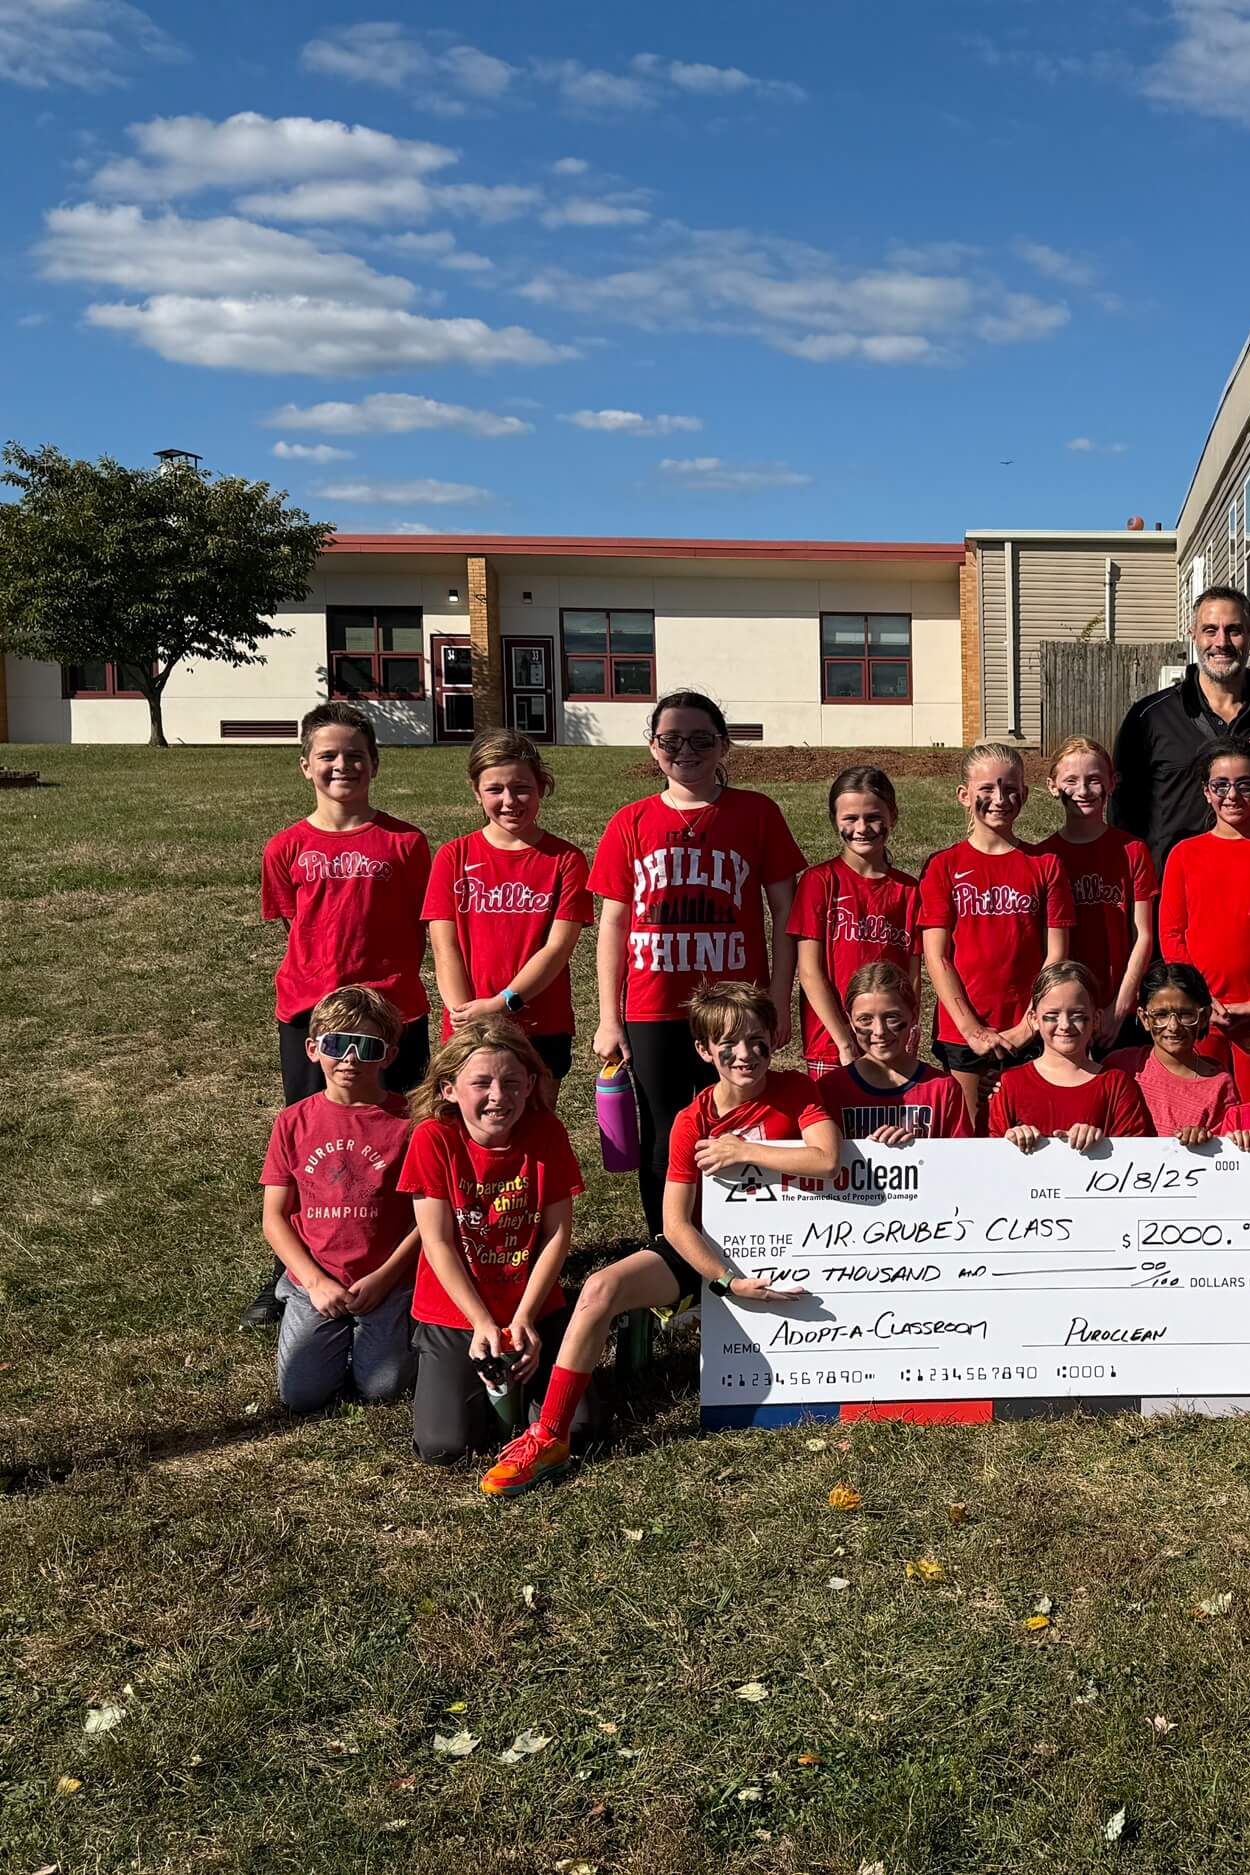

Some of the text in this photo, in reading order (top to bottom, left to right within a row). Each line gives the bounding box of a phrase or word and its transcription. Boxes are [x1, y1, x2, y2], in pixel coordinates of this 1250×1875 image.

[298, 850, 393, 882] Phillies
[951, 882, 1040, 918] Phillies
[826, 906, 912, 947] Phillies
[629, 930, 747, 973] THING
[304, 1138, 387, 1175] BURGER RUN
[1214, 1160, 1240, 1171] 0001
[1086, 1162, 1207, 1193] 10/8/25
[476, 1175, 529, 1198] parents
[1030, 1188, 1061, 1199] DATE
[782, 1193, 919, 1203] The Paramedics of Property Damage
[306, 1206, 379, 1219] CHAMPION
[497, 1209, 542, 1230] they're
[801, 1206, 1073, 1249] MR. GRUBE'S CLASS
[504, 1233, 518, 1248] in
[723, 1233, 793, 1246] PAY TO THE
[1122, 1233, 1131, 1249] $
[480, 1249, 530, 1266] charge
[723, 1246, 787, 1258] ORDER OF
[751, 1266, 810, 1283] TWO
[822, 1264, 942, 1283] THOUSAND
[1190, 1276, 1246, 1289] DOLLARS
[722, 1342, 761, 1354] MEMO
